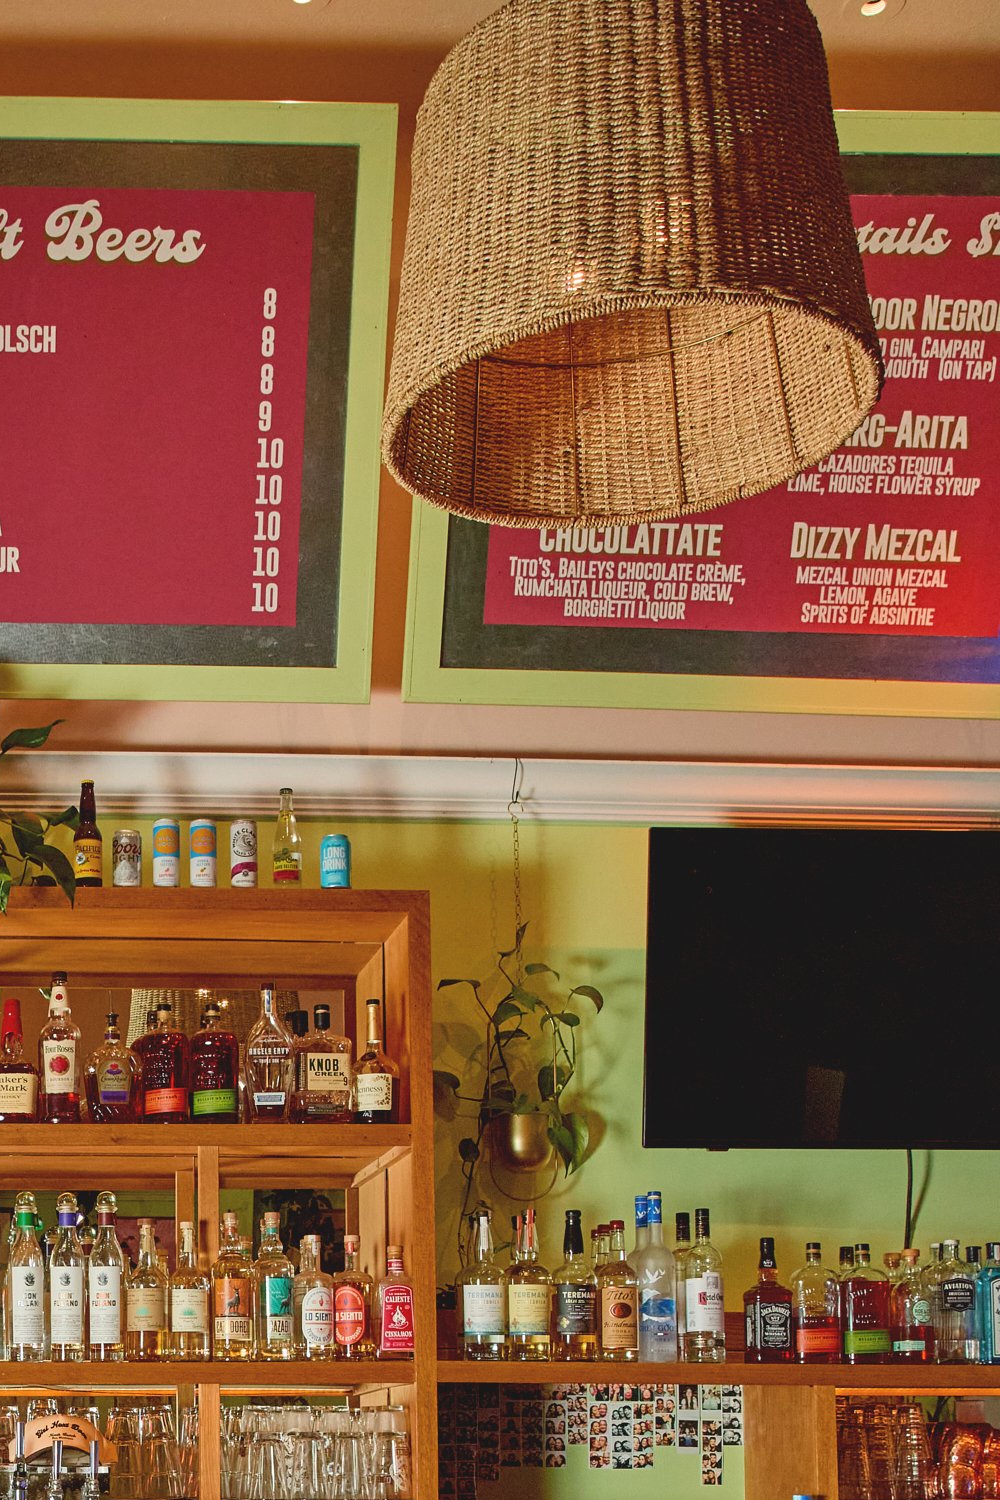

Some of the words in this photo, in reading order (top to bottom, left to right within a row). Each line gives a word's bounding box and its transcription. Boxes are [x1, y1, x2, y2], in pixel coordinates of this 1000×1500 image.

[45, 200, 206, 263] Beers
[539, 520, 724, 556] CHOCOLATTATE
[790, 522, 861, 560] DIZZY
[864, 524, 961, 562] MEZCAL
[509, 556, 555, 579] TITO'S,
[558, 558, 614, 579] BAILEYS
[617, 562, 693, 582] CHOCOLATE
[696, 561, 746, 586] CRÈME,
[514, 576, 588, 598] RUMCHATA
[591, 580, 650, 602] LIQUEUR,
[654, 582, 688, 600] COLD
[691, 583, 734, 605] BREW,
[564, 600, 635, 618] BORGHETTI
[638, 601, 685, 622] LIQUOR
[324, 847, 345, 858] LONG
[322, 860, 347, 870] DRINK
[309, 1058, 339, 1071] KNOB
[0, 1084, 27, 1092] Mark
[944, 1283, 974, 1291] AVIATION
[607, 1290, 634, 1300] Tito's
[340, 1311, 363, 1321] SIENTO
